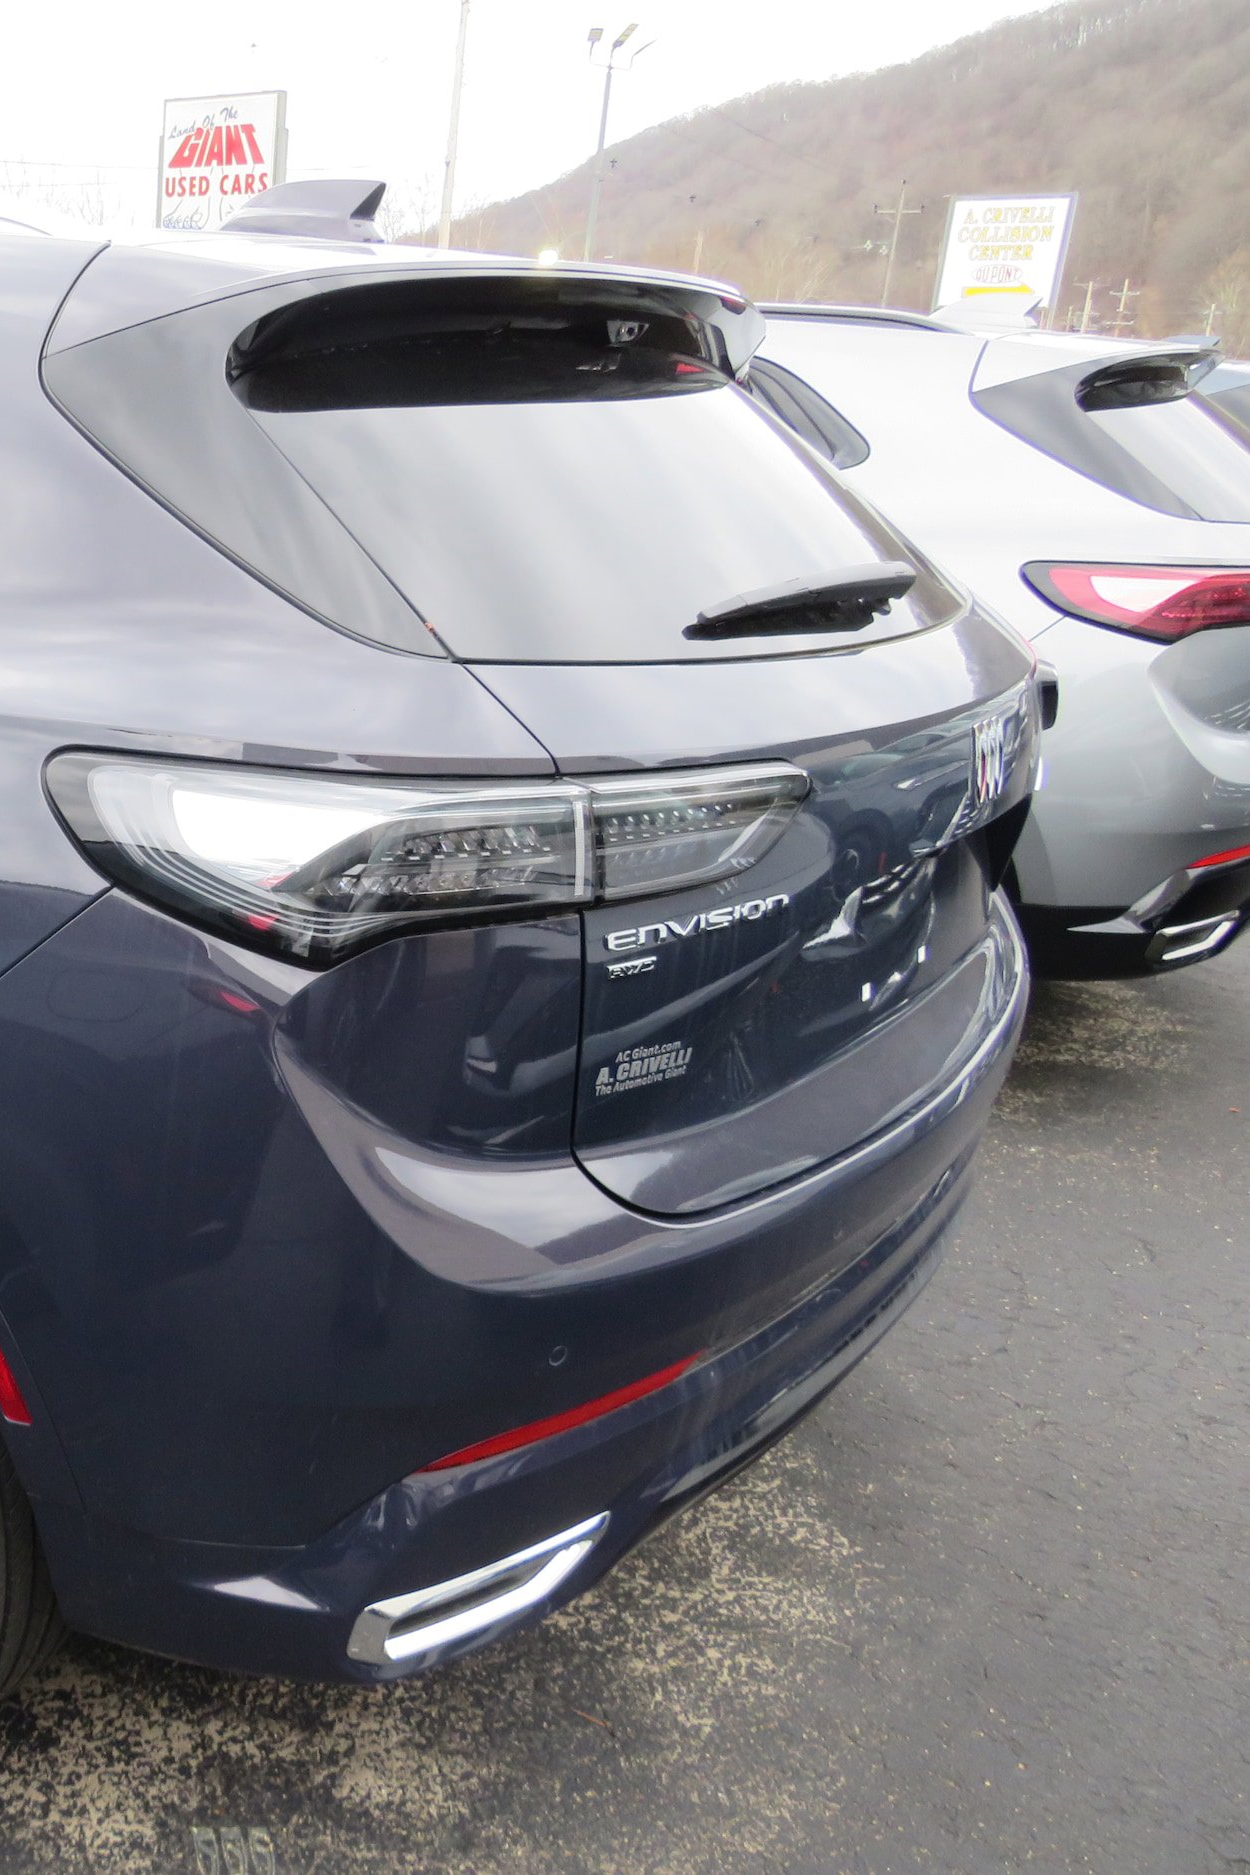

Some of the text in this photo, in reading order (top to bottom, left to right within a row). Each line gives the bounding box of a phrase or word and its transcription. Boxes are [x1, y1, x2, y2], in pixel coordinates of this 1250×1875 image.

[168, 106, 238, 139] Land Of The
[168, 124, 264, 168] GIANT
[165, 172, 268, 197] USED CARS
[963, 206, 1056, 224] A. CRIVELLI
[957, 225, 1054, 243] COLLISION
[969, 244, 1033, 261] CENTER
[605, 893, 790, 951] ENVISION
[595, 1047, 692, 1085] A. CRIVELLI
[615, 1041, 681, 1063] AC Giant.com
[595, 1065, 687, 1096] The Automotive Giant
